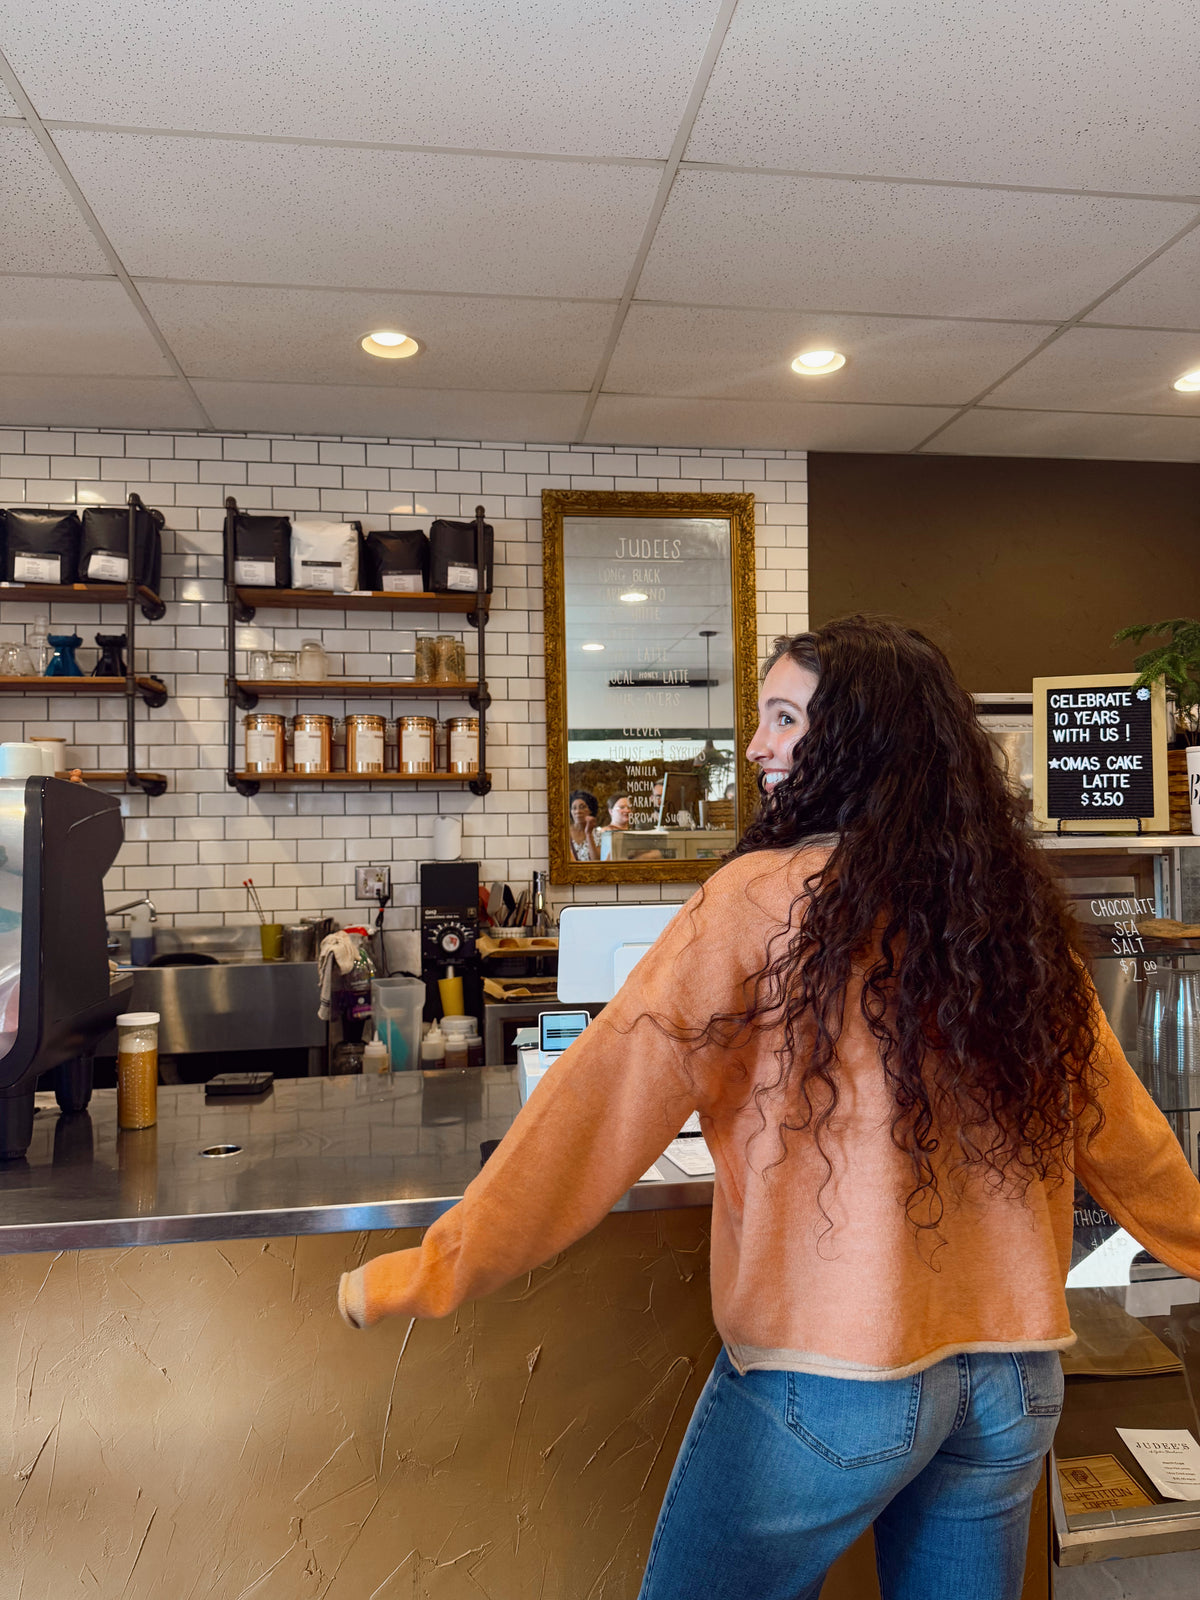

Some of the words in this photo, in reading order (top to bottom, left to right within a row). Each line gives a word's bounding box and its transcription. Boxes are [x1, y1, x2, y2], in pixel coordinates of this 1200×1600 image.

[615, 537, 682, 560] JUDEES
[632, 568, 661, 584] BLACK
[638, 671, 659, 679] HONEY
[662, 668, 690, 684] LATTE
[1050, 692, 1132, 708] CELEBRATE
[1054, 712, 1069, 726] 10
[1074, 710, 1120, 725] YEARS
[622, 725, 662, 737] CLEVER
[1052, 728, 1090, 743] WITH
[1100, 727, 1119, 742] US
[609, 745, 643, 760] HOUSE
[669, 744, 706, 761] SYRUPS
[625, 765, 657, 777] VANILLA
[1060, 756, 1100, 771] OMAS
[1106, 755, 1143, 770] CAKE
[626, 780, 655, 793] MOCHA
[1082, 773, 1130, 789] LATTE
[1080, 791, 1124, 806] $3.50
[629, 812, 659, 825] BROWN
[1090, 897, 1157, 917] CHOCOLATE
[1113, 919, 1140, 938] SEA
[1111, 937, 1145, 955] SALT
[1119, 958, 1157, 982] $2.00
[1073, 1209, 1117, 1226] THIOPI
[1135, 1441, 1191, 1450] JUDEE'S
[1064, 1487, 1134, 1502] EPETITION
[1082, 1498, 1123, 1510] COFFEE
